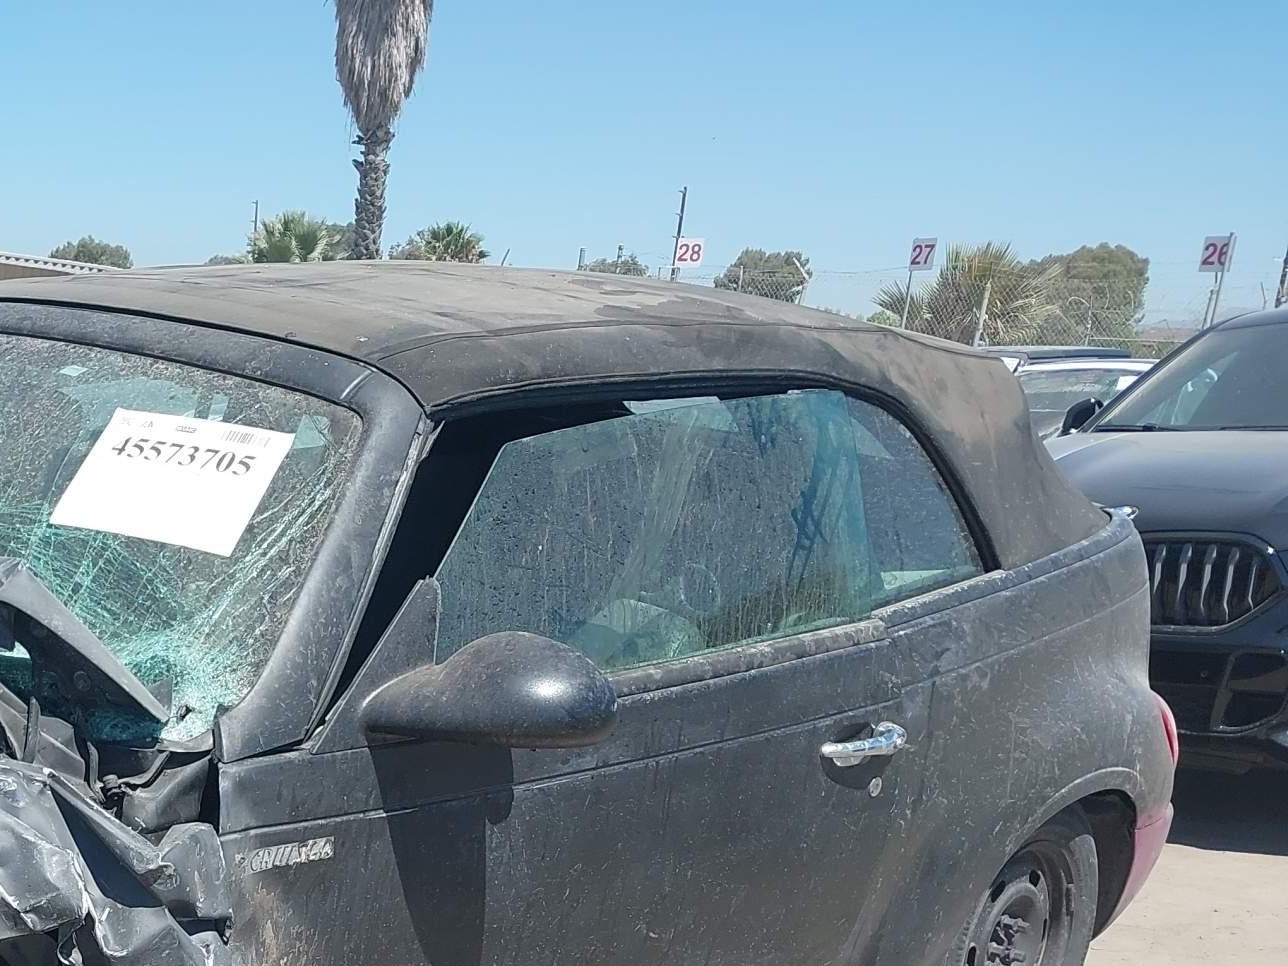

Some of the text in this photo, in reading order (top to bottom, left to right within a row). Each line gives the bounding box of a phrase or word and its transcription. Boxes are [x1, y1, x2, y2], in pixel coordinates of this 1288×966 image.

[677, 243, 702, 262] 28
[911, 244, 936, 265] 27
[1202, 243, 1228, 266] 26
[111, 436, 257, 476] 45573705
